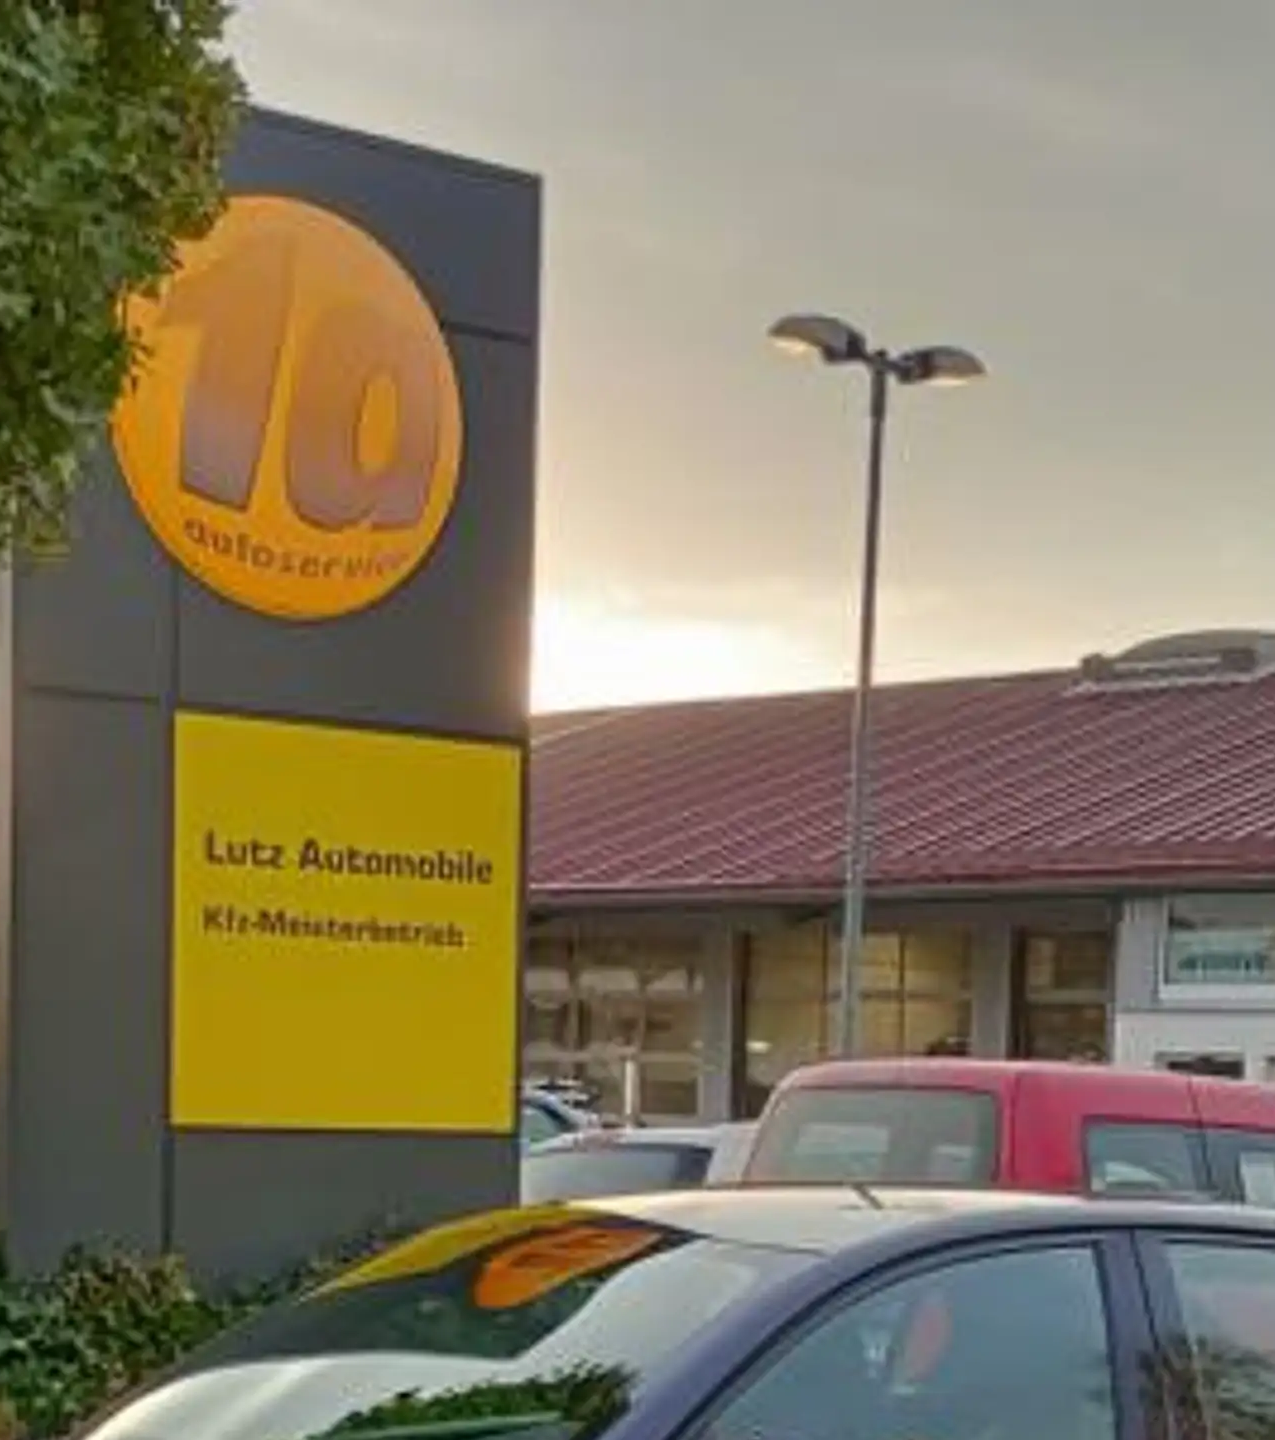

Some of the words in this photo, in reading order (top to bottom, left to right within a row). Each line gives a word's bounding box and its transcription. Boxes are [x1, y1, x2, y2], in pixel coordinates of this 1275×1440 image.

[205, 829, 284, 870] Lutz
[298, 837, 494, 884] Automobile
[203, 903, 466, 948] Kfz-Meisterbetrieb
